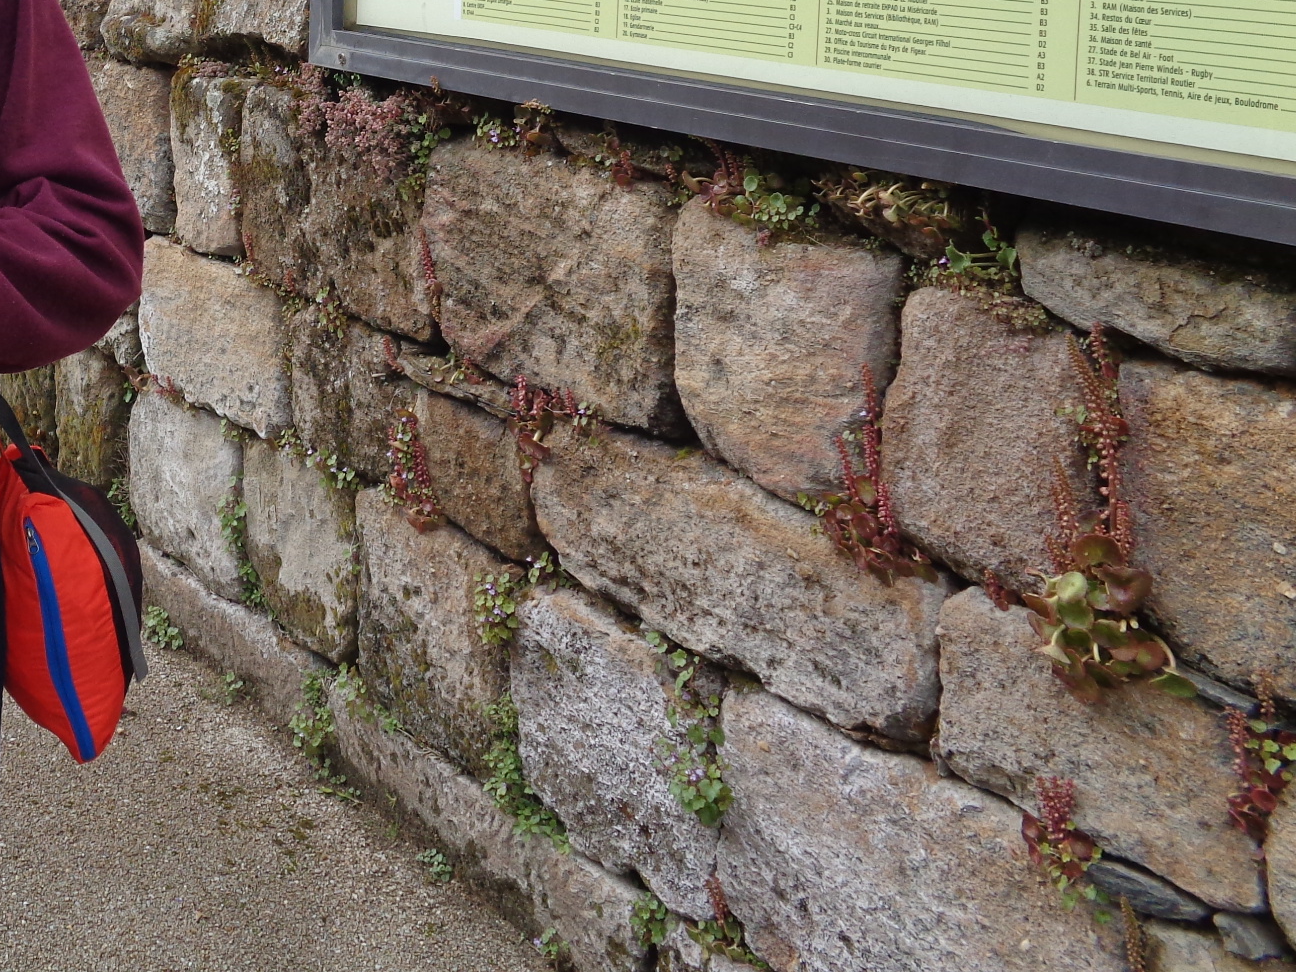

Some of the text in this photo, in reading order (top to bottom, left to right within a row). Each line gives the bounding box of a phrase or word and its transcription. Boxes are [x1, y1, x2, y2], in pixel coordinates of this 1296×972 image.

[1090, 1, 1192, 18] 3. RAM (Maison des Services)
[1086, 79, 1279, 111] 6. Terrain Multi-Sports, Tennis, Aire de jeux, Boulodrome
